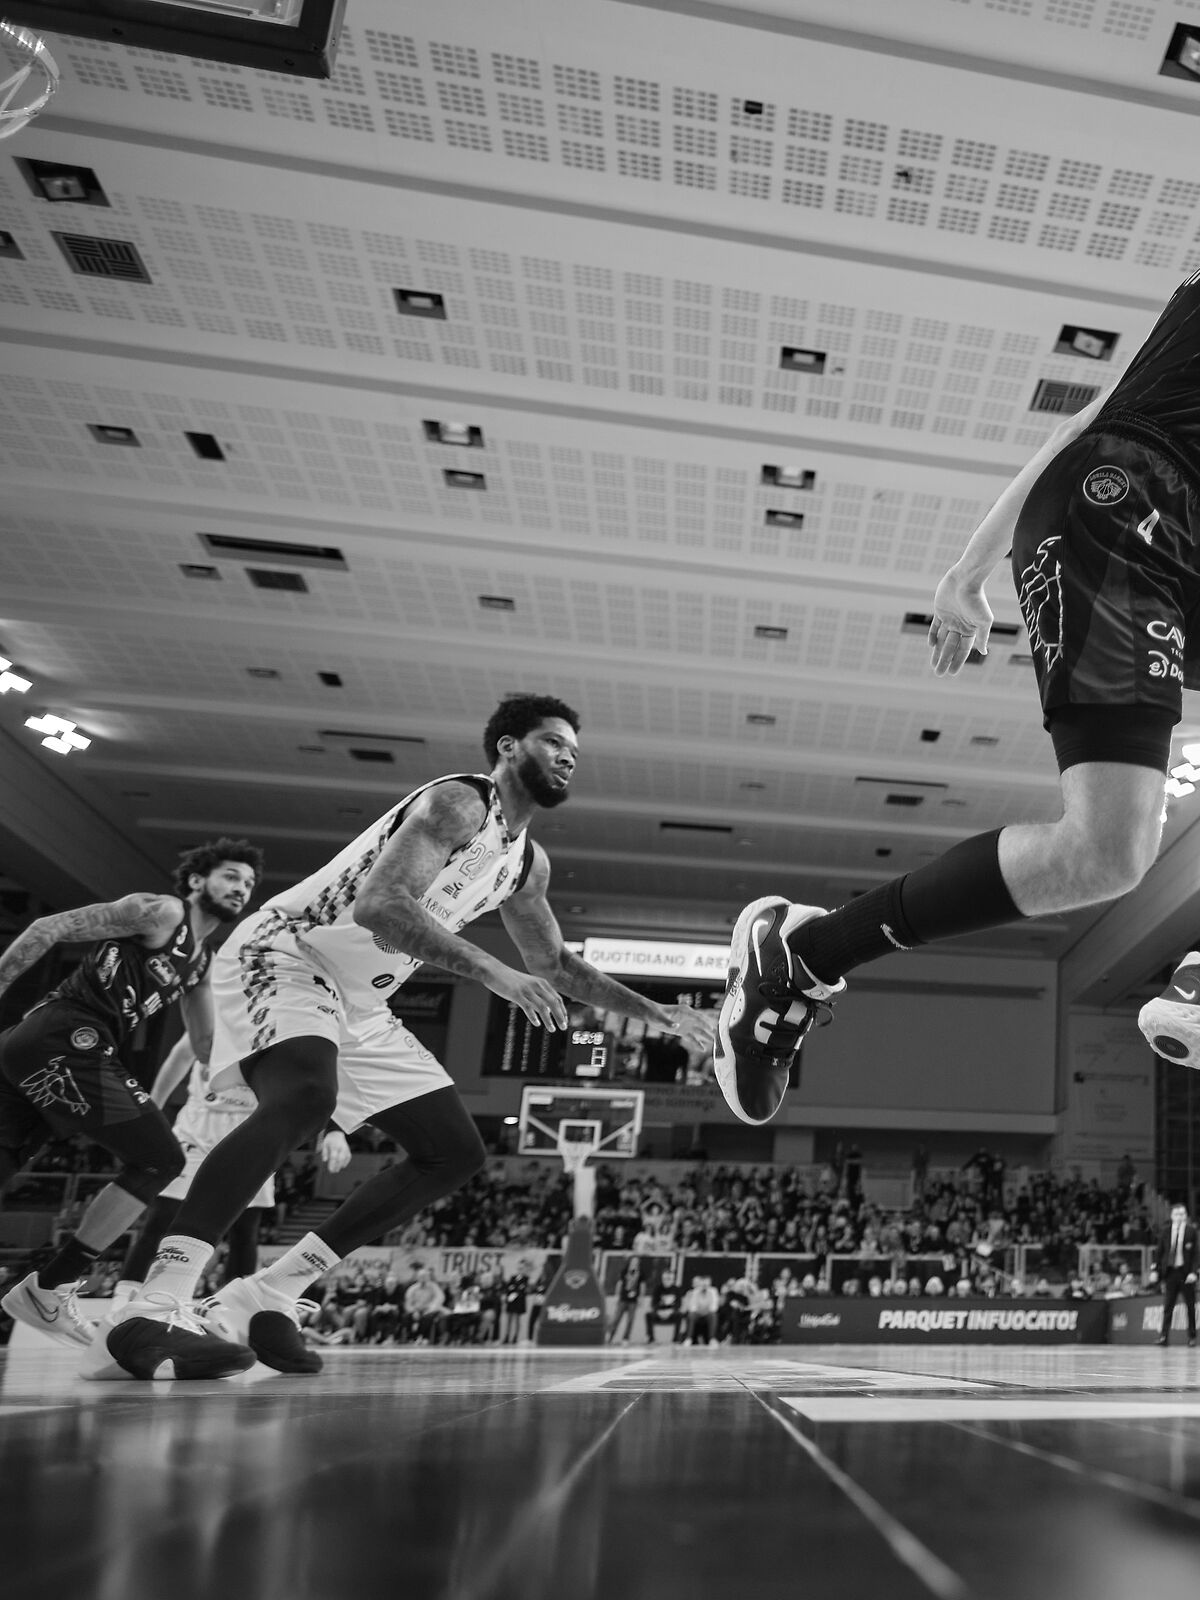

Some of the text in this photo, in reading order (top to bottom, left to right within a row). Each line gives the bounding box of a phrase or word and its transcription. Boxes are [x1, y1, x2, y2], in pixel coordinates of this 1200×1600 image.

[1137, 509, 1159, 545] 4
[590, 950, 686, 966] QUOTIDIANO
[878, 1310, 967, 1332] PARQUET
[966, 1310, 1079, 1331] INFUOCATO!
